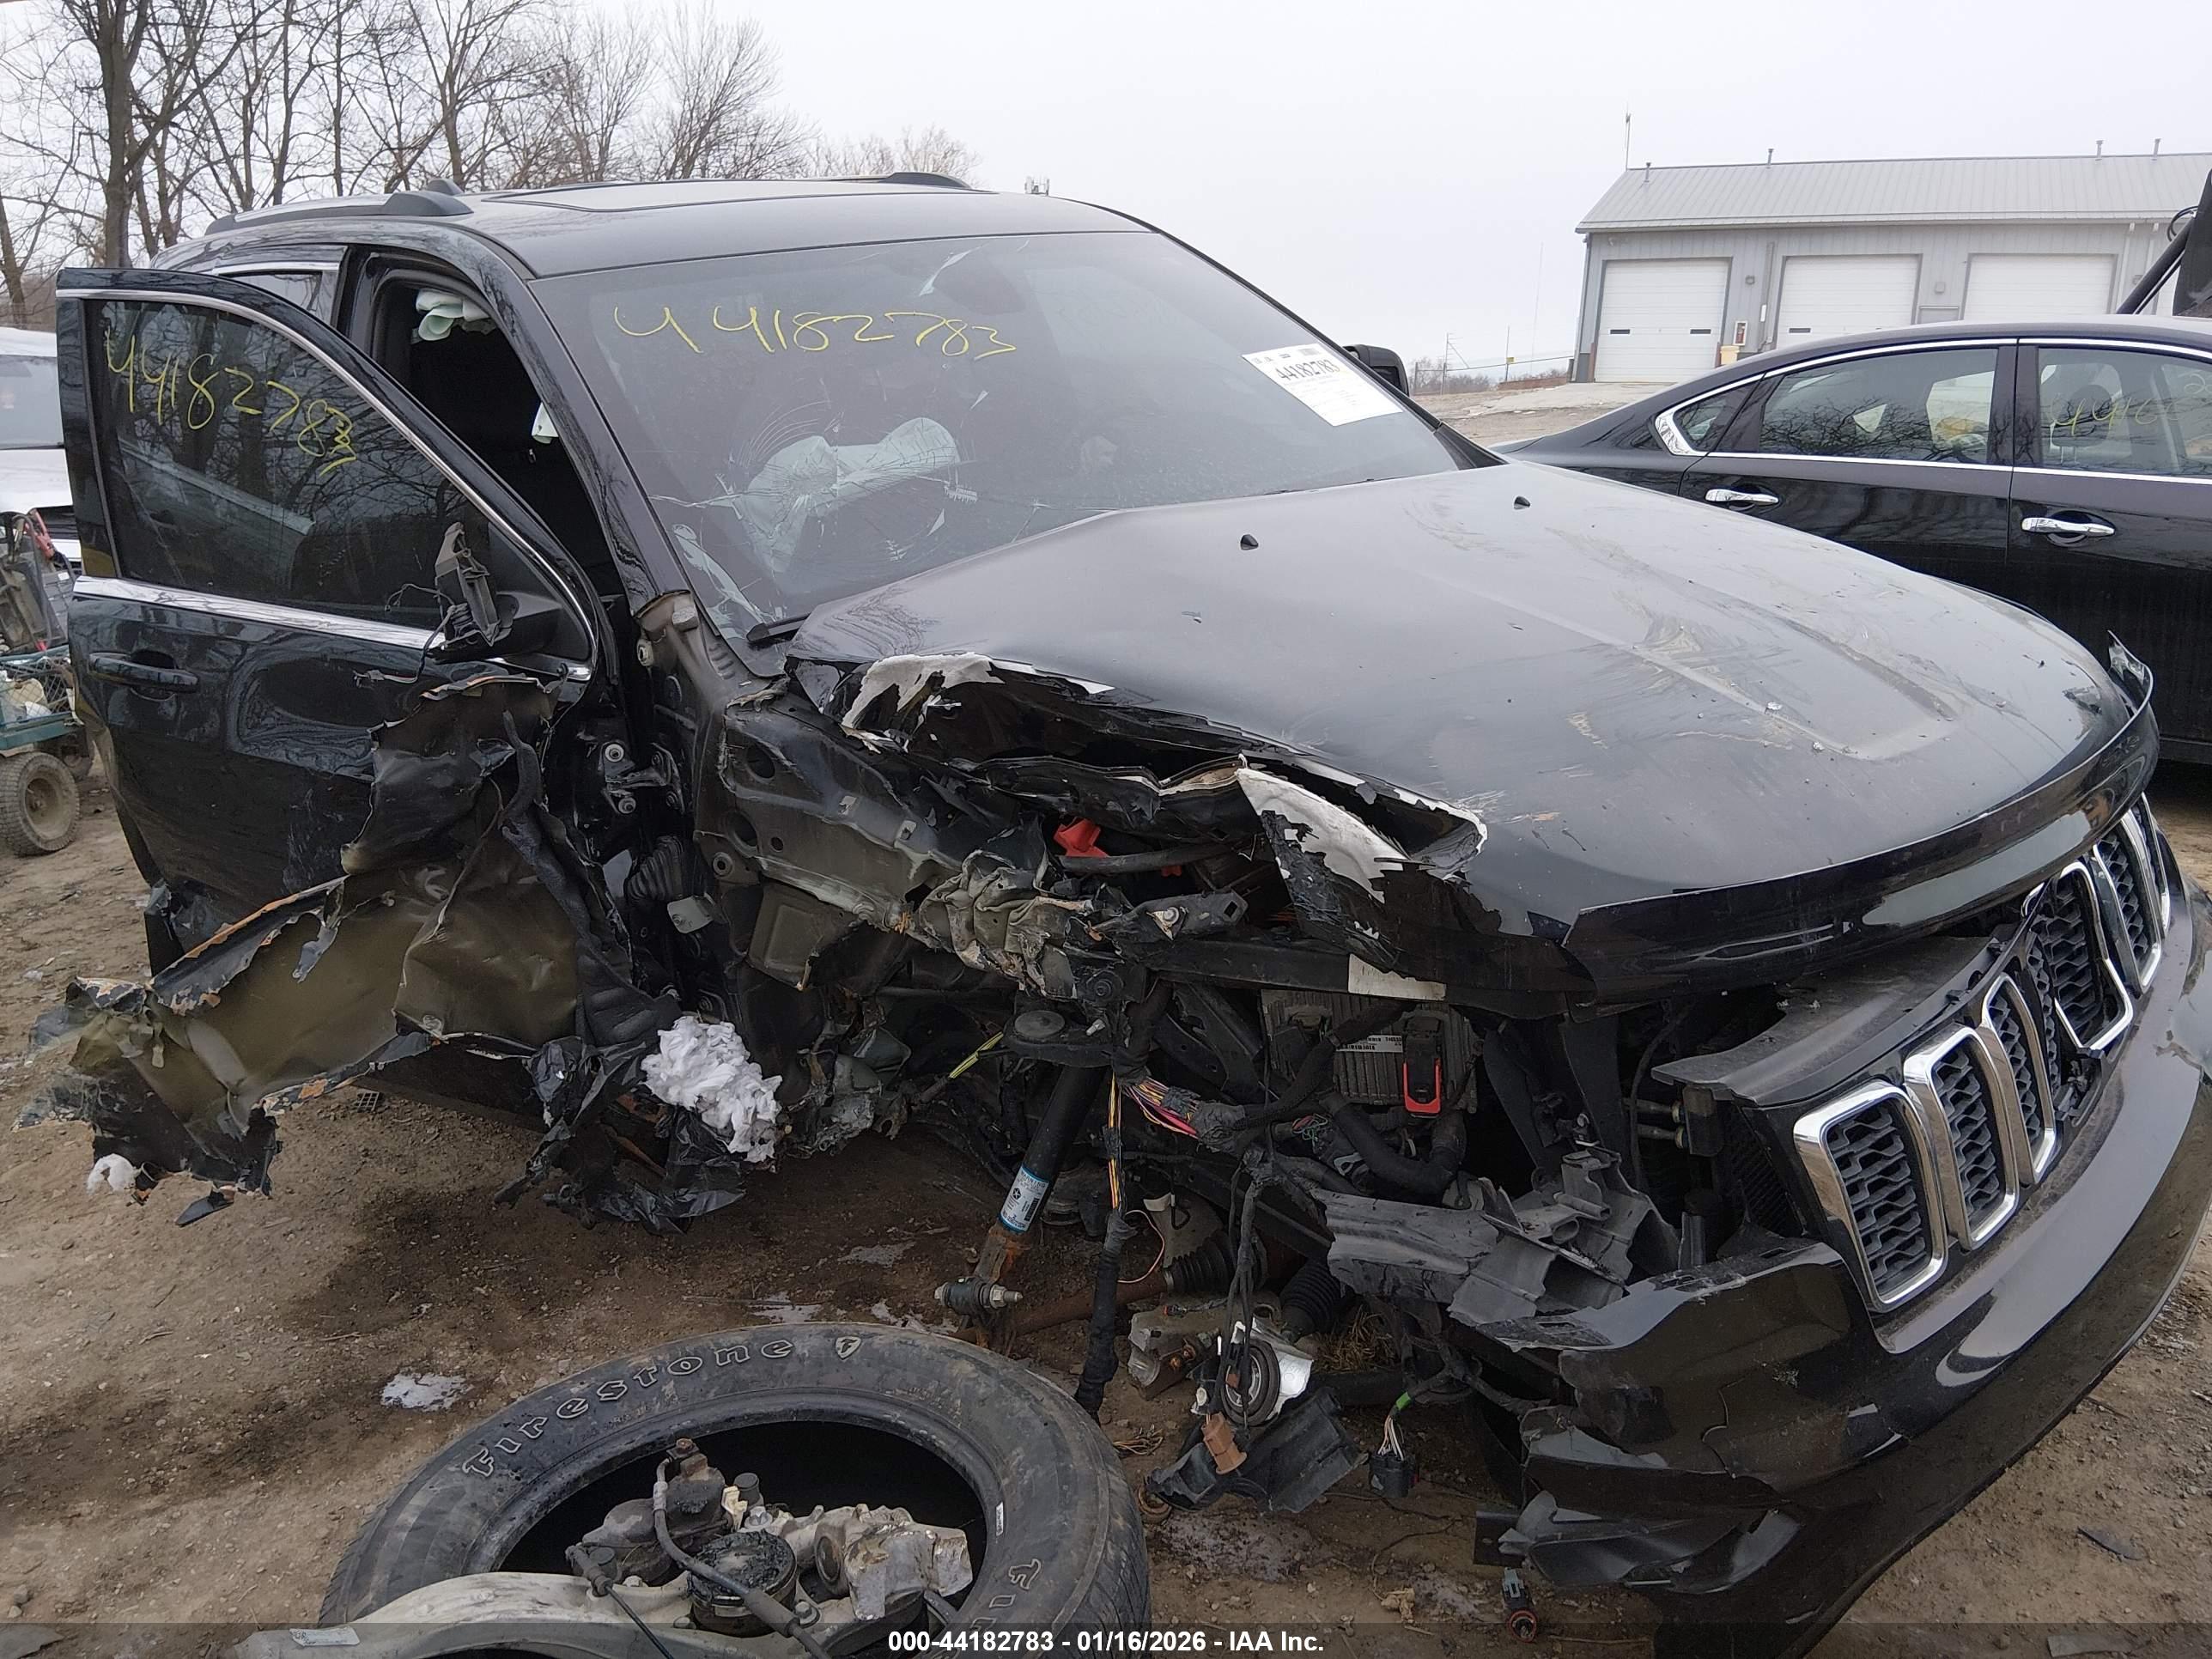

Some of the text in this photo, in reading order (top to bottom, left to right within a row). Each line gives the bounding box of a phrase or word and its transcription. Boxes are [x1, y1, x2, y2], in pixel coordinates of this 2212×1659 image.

[613, 305, 1018, 361] 44182783
[1275, 359, 1340, 380] 44182783
[462, 1339, 794, 1477] Firestone
